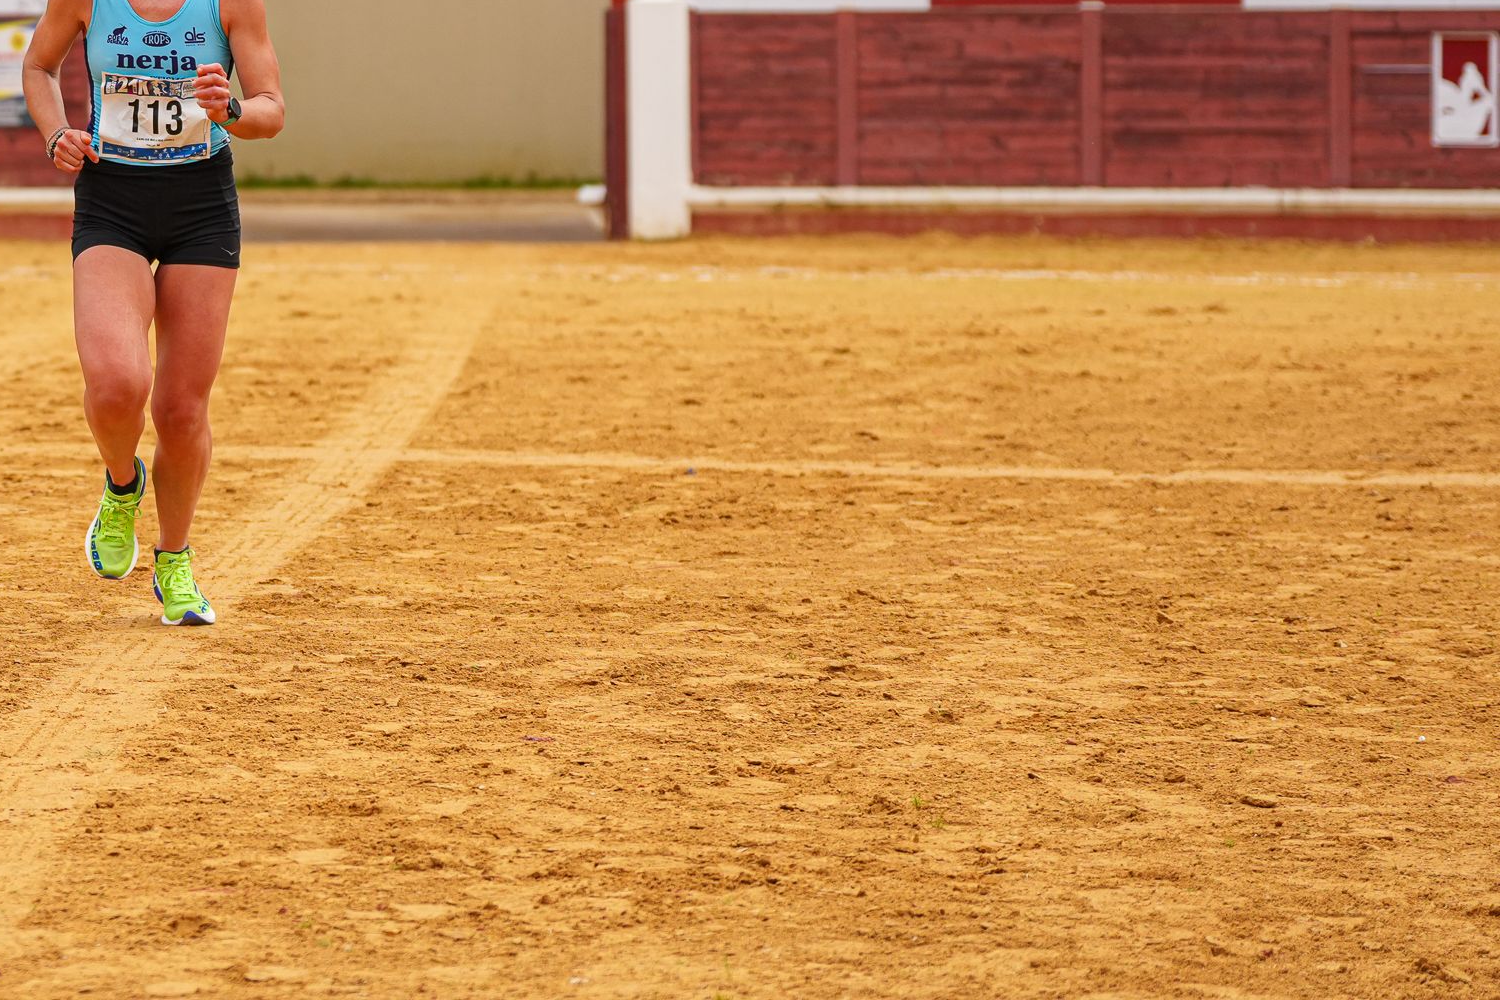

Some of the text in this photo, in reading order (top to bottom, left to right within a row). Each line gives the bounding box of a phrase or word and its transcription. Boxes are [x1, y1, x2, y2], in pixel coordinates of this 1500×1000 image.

[144, 34, 169, 45] TROPS
[116, 50, 197, 75] nerja
[128, 98, 183, 136] 113
